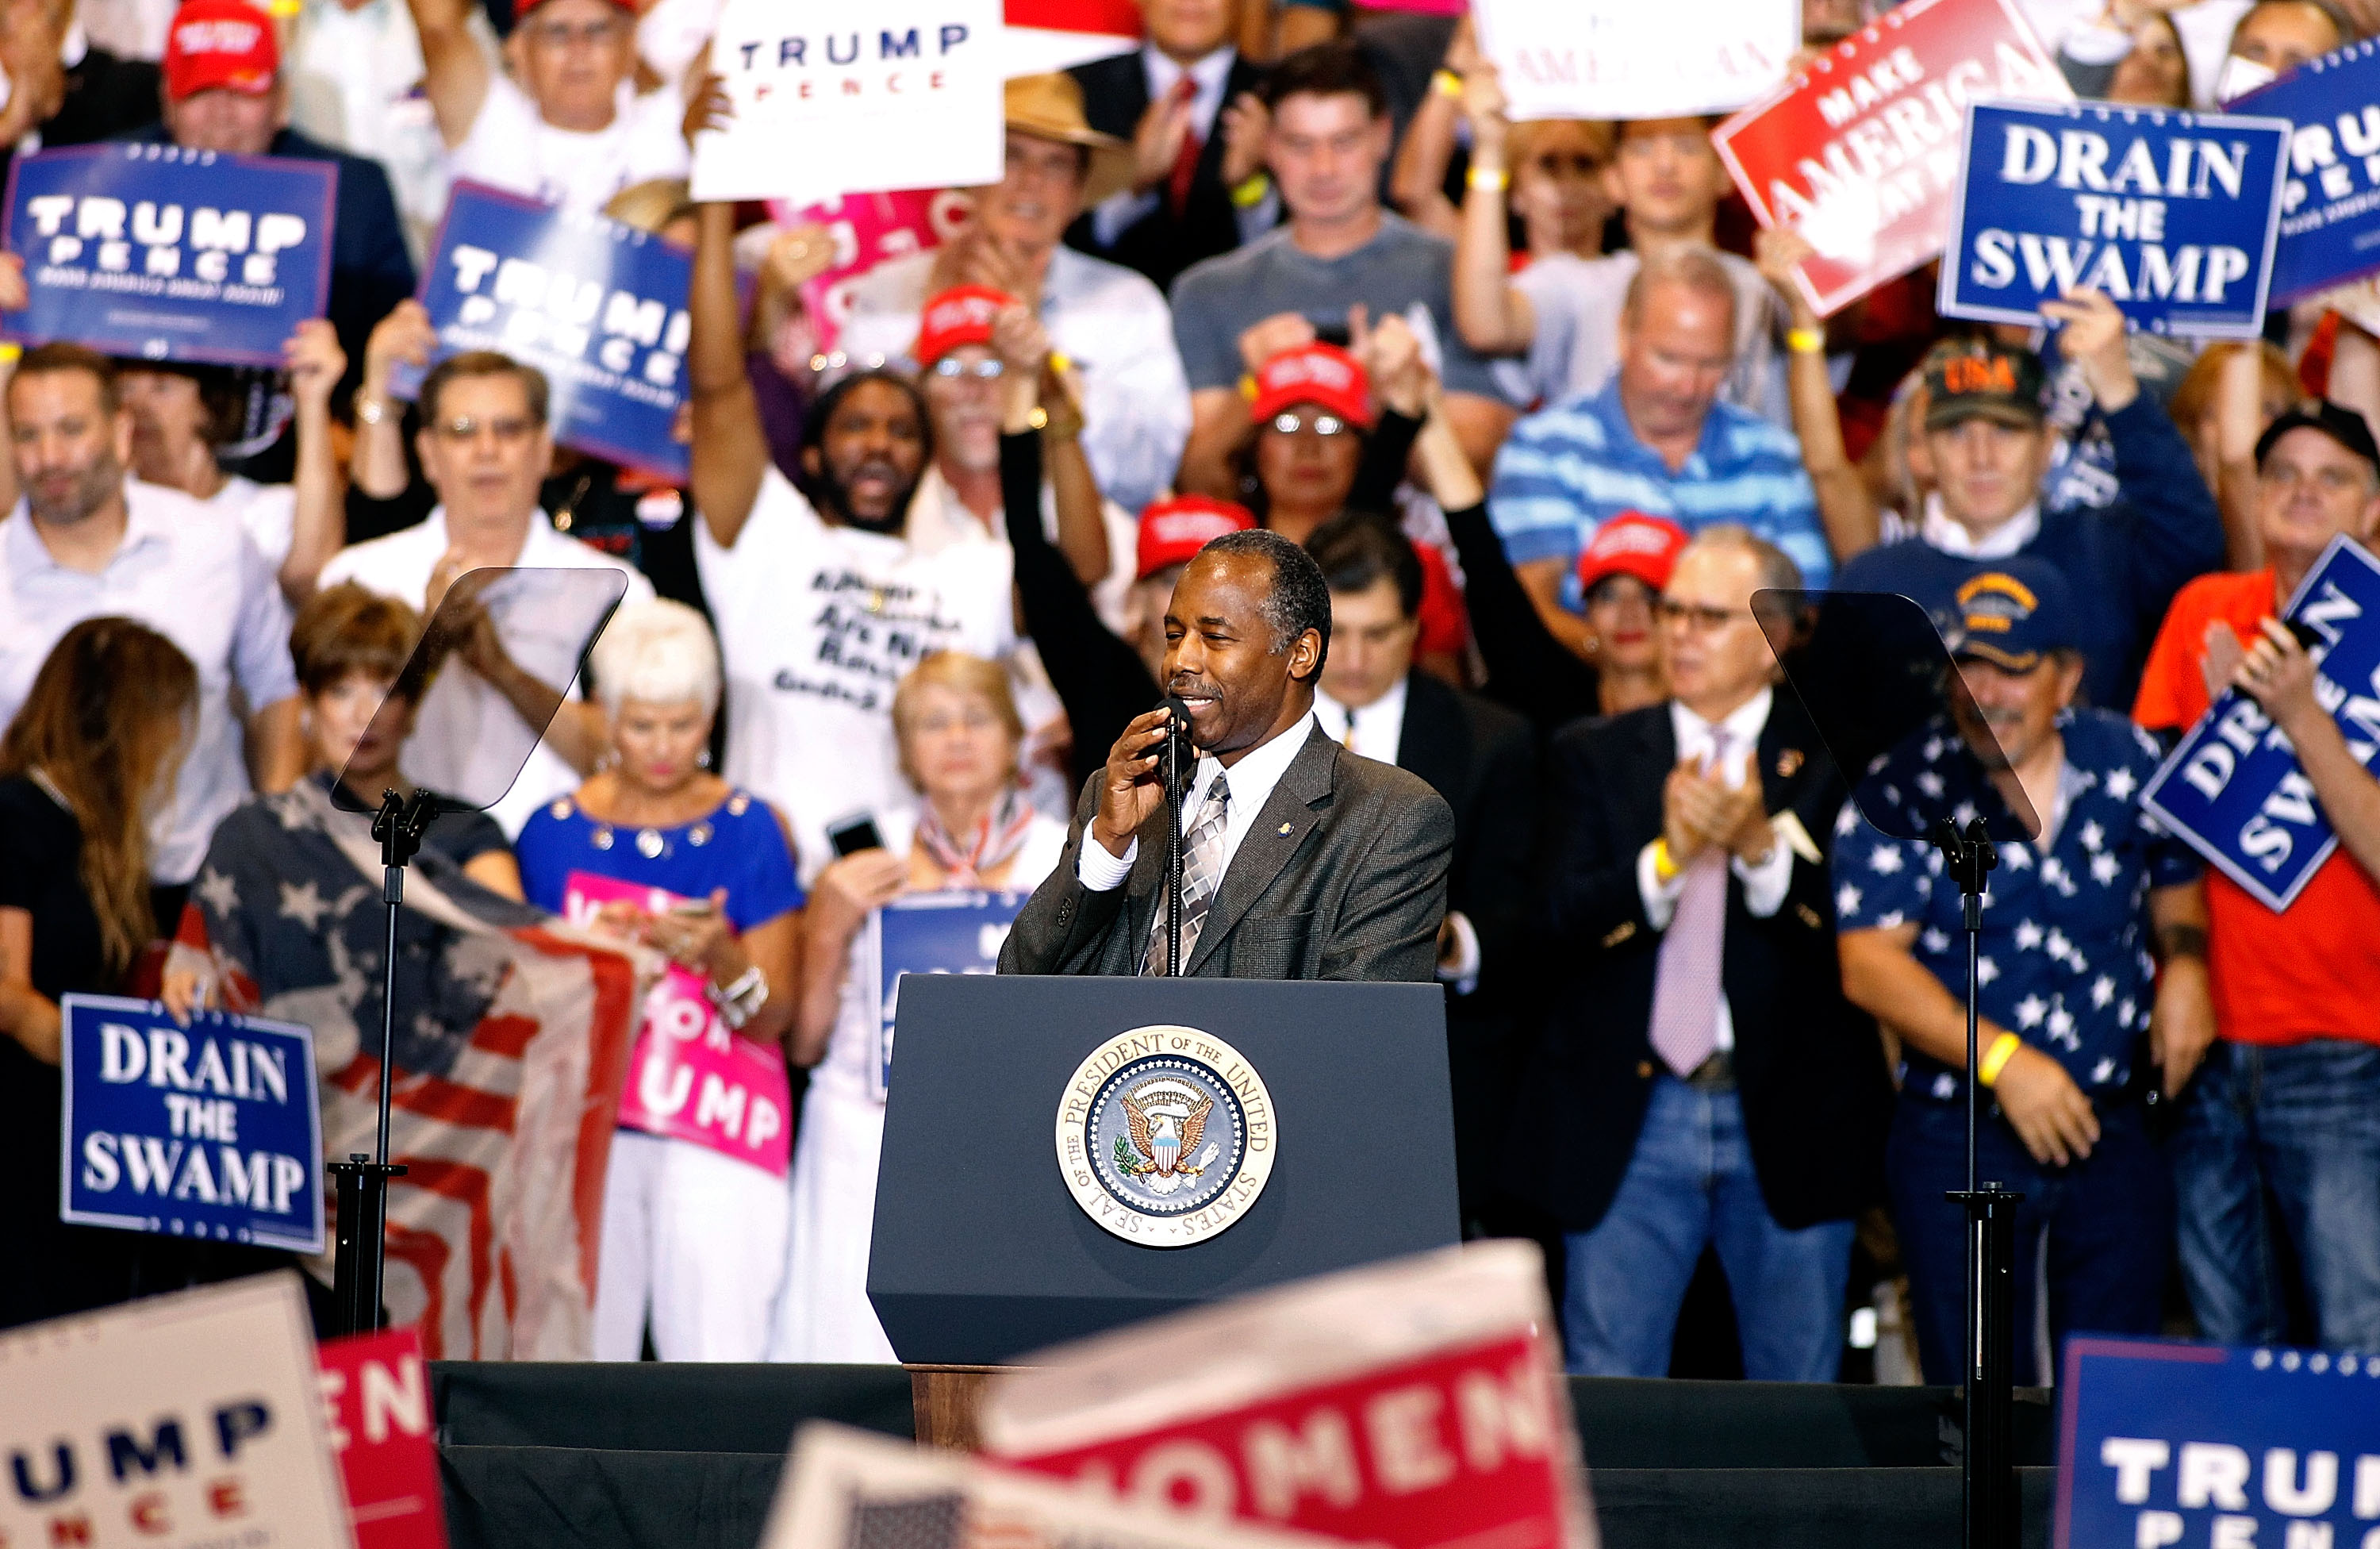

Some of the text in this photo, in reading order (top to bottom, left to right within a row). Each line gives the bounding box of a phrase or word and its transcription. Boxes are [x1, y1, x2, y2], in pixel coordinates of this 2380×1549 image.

[739, 23, 971, 71] TRUMP
[754, 70, 947, 102] PENCE
[1818, 46, 1925, 127] MAKE
[2000, 122, 2250, 200] DRAIN
[28, 194, 307, 254] TRUMP
[2074, 194, 2167, 241] THE
[49, 236, 278, 286] PENCE
[1971, 229, 2250, 305] SWAMP
[2182, 577, 2364, 805] DRN
[99, 1021, 289, 1106] DRAIN
[163, 1093, 238, 1143] THE
[1065, 1033, 1269, 1236] SEAL OF THE PRESIDENT OF THE UNITED STATES
[82, 1130, 306, 1216] SWAMP
[1073, 1359, 1552, 1527] OMEN
